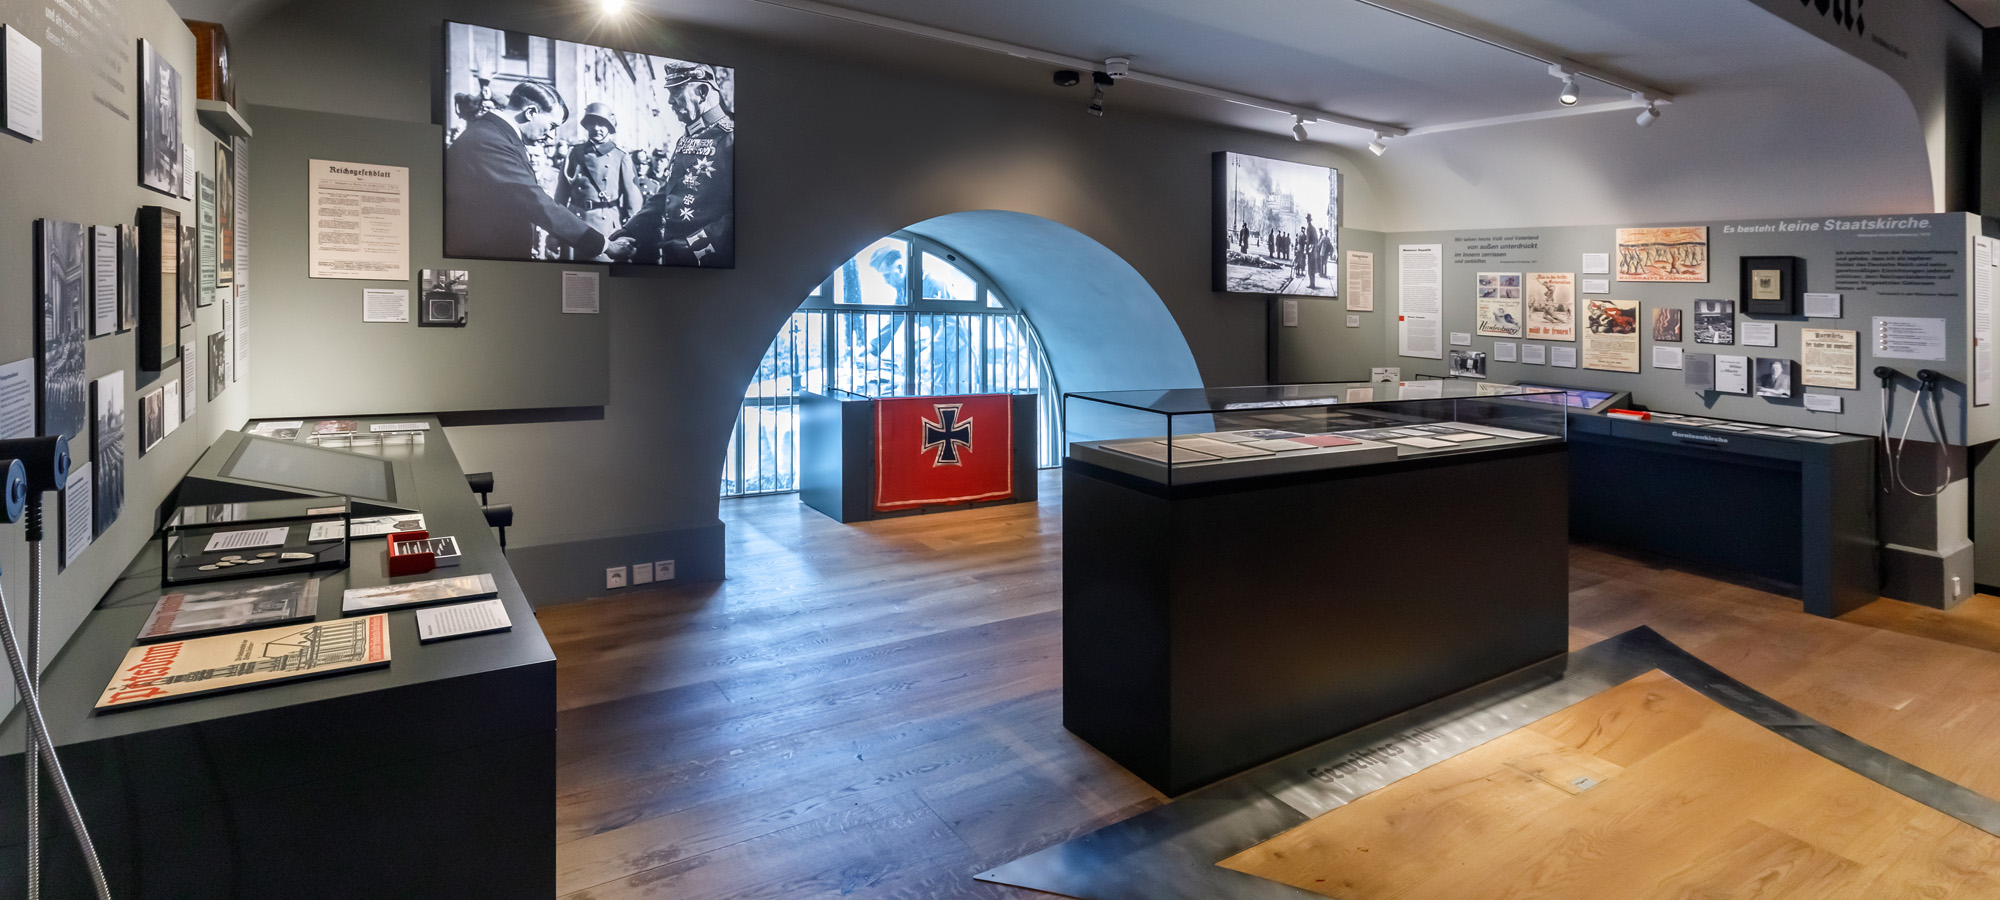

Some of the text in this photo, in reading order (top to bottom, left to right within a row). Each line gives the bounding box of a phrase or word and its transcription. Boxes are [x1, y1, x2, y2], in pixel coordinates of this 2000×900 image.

[1723, 217, 1932, 233] Es besteht keine Staatskirche.
[1672, 431, 1728, 443] Garnisonkirche
